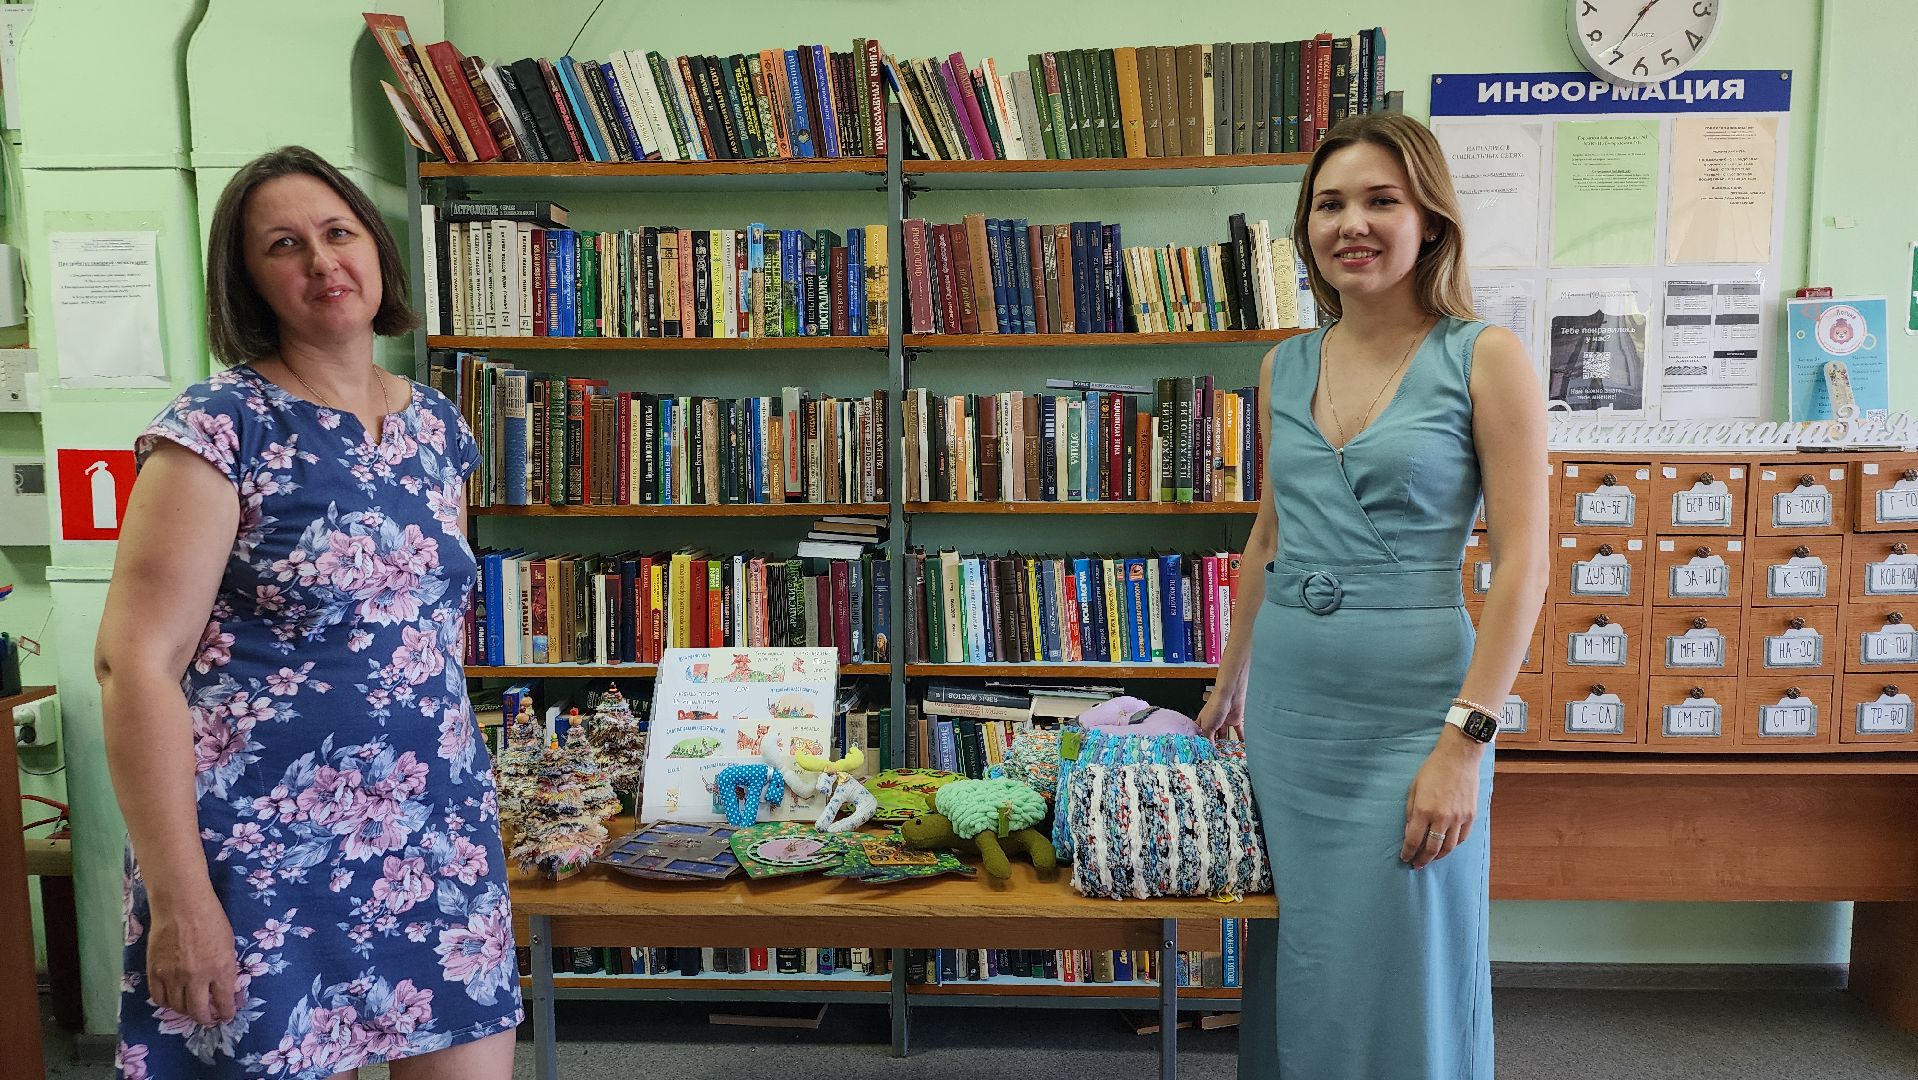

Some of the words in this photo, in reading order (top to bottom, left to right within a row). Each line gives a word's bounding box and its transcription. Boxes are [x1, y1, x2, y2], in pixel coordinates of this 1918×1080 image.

[869, 45, 879, 76] КНИГА
[1608, 50, 1624, 66] 7
[1632, 56, 1649, 77] 6
[1660, 48, 1680, 68] 5
[1376, 56, 1384, 101] ФИЛОСОФИЯ
[1477, 78, 1746, 104] ИНФОРМАЦИЯ
[1349, 81, 1358, 115] ЕГЕЛЬ
[872, 81, 885, 150] ПРАВОСЛАВНАЯ
[912, 227, 923, 277] ФИЛОСОФИЯ
[817, 275, 829, 330] НОСТРАДАМУС
[1560, 326, 1580, 335] Тебе
[1581, 325, 1636, 335] понравилось
[694, 444, 702, 466] Встреча
[1071, 432, 1079, 465] ЭТИКА
[1162, 401, 1170, 478] ПСИХОЛОГИЯ
[1080, 571, 1090, 624] ПСИХОЛОГИЯ
[948, 692, 977, 701] ЖЕСТОВ
[976, 694, 999, 703] ЯЗЫК
